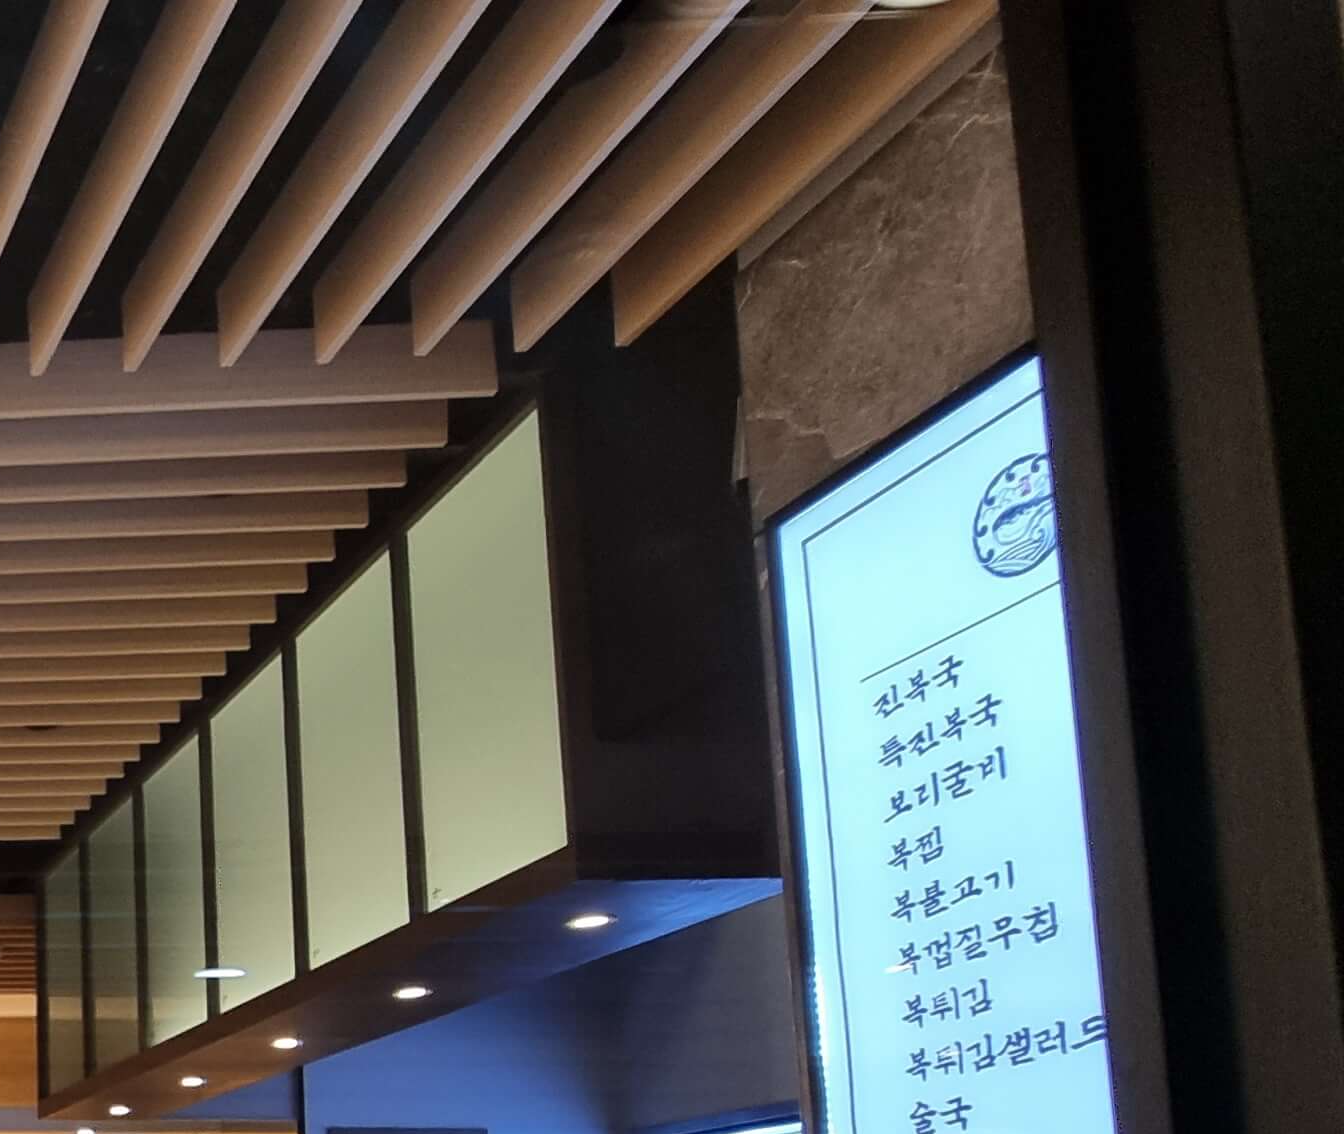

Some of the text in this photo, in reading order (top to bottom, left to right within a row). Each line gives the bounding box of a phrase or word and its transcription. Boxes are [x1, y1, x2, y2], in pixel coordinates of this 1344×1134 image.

[873, 655, 964, 718] 진복국
[878, 693, 1003, 768] 특진복국
[884, 745, 1007, 824] 보리굴비
[887, 825, 944, 872] 복찜
[890, 860, 1014, 923] 복불고기
[898, 901, 1059, 975] 복껍질무침
[901, 978, 993, 1029] 복튀김
